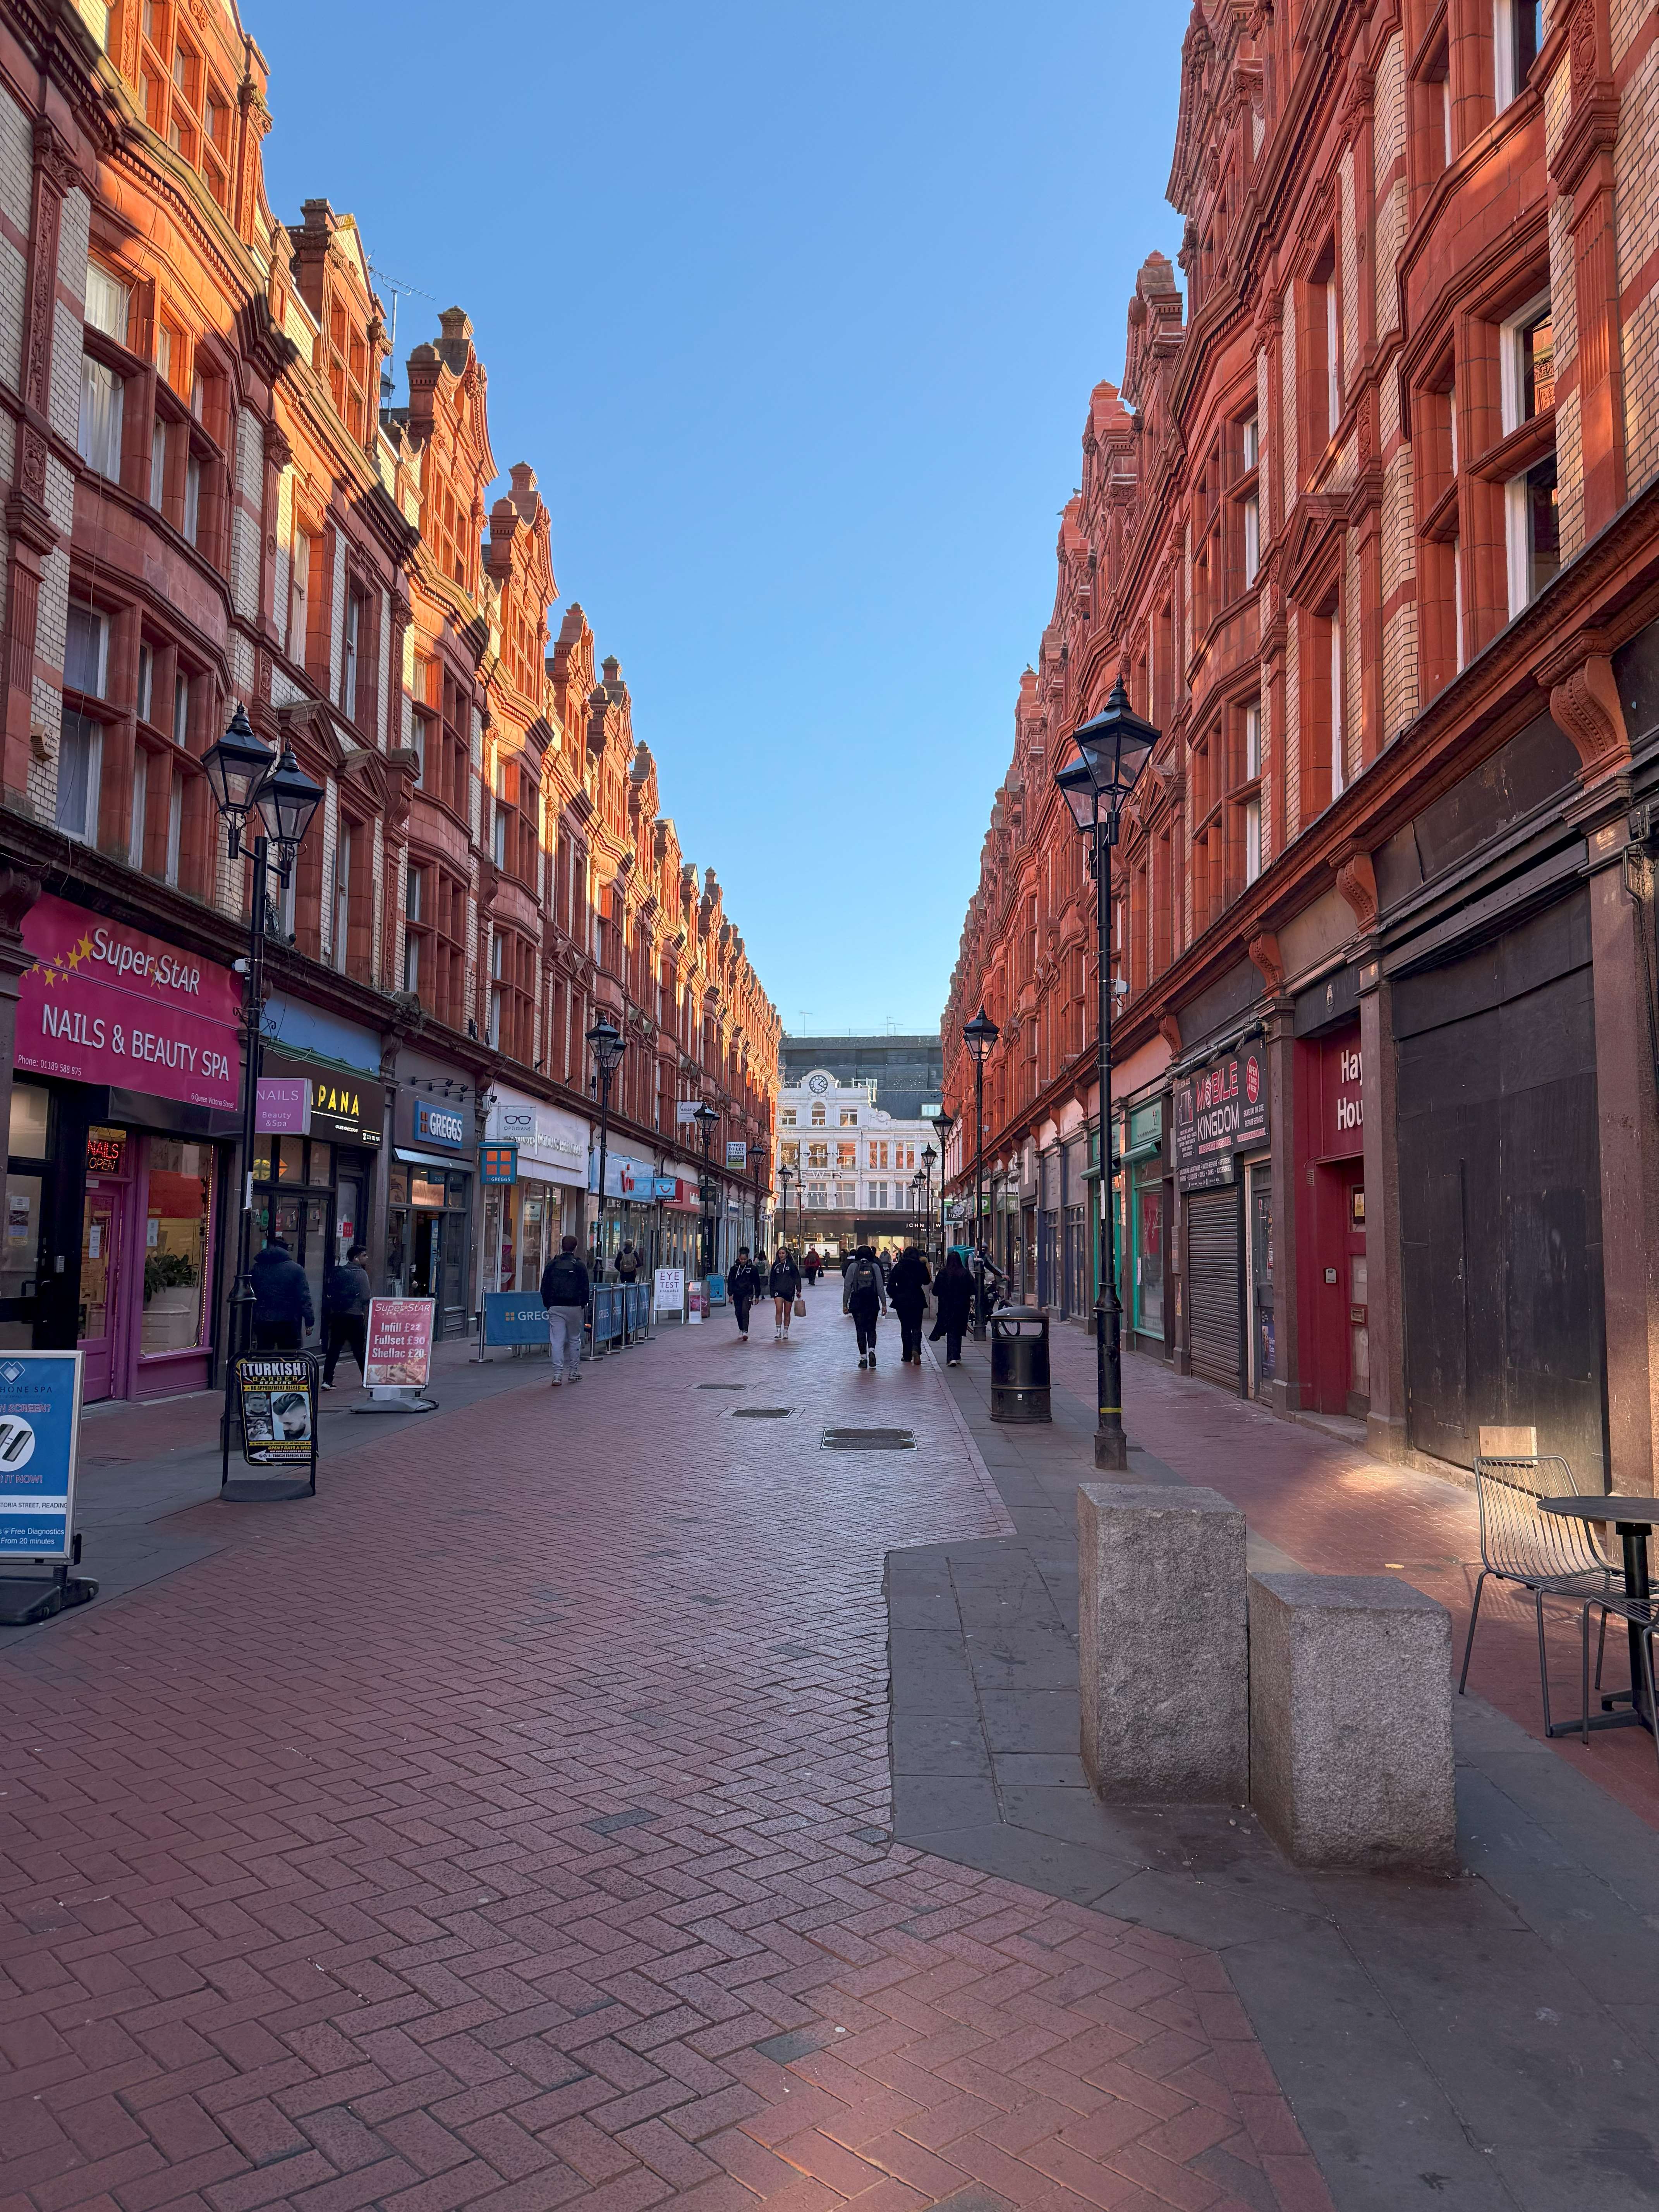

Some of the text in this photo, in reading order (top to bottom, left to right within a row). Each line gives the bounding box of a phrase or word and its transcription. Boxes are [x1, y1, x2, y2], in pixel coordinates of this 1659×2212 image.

[91, 928, 154, 976] Super
[42, 1004, 229, 1081] NAILS & BEAUTY SPA
[18, 1054, 82, 1076] Phone: 01189 588 875
[1248, 1065, 1257, 1077] OPEN
[1196, 1061, 1238, 1112] MOBILE
[195, 1094, 208, 1103] Queen
[208, 1097, 222, 1106] Victoria
[223, 1099, 234, 1108] Street
[256, 1090, 299, 1101] NAILS
[429, 1113, 462, 1142] GREGGS
[1197, 1102, 1240, 1142] KINGDOM
[88, 1139, 118, 1159] NAILS
[794, 1148, 840, 1160] JOHN
[89, 1157, 115, 1171] OPEN
[800, 1170, 843, 1180] EWIS
[660, 1272, 680, 1280] EYE
[374, 1304, 405, 1314] Super
[381, 1322, 421, 1332] Infill £22
[374, 1335, 425, 1345] Fullset £30
[372, 1348, 424, 1358] Shellac £20
[247, 1363, 301, 1376] TURKISH
[8, 1403, 52, 1413] SCREEN?
[5, 1475, 14, 1483] IT
[15, 1475, 43, 1484] NOW!
[27, 1528, 65, 1536] Diagnostics
